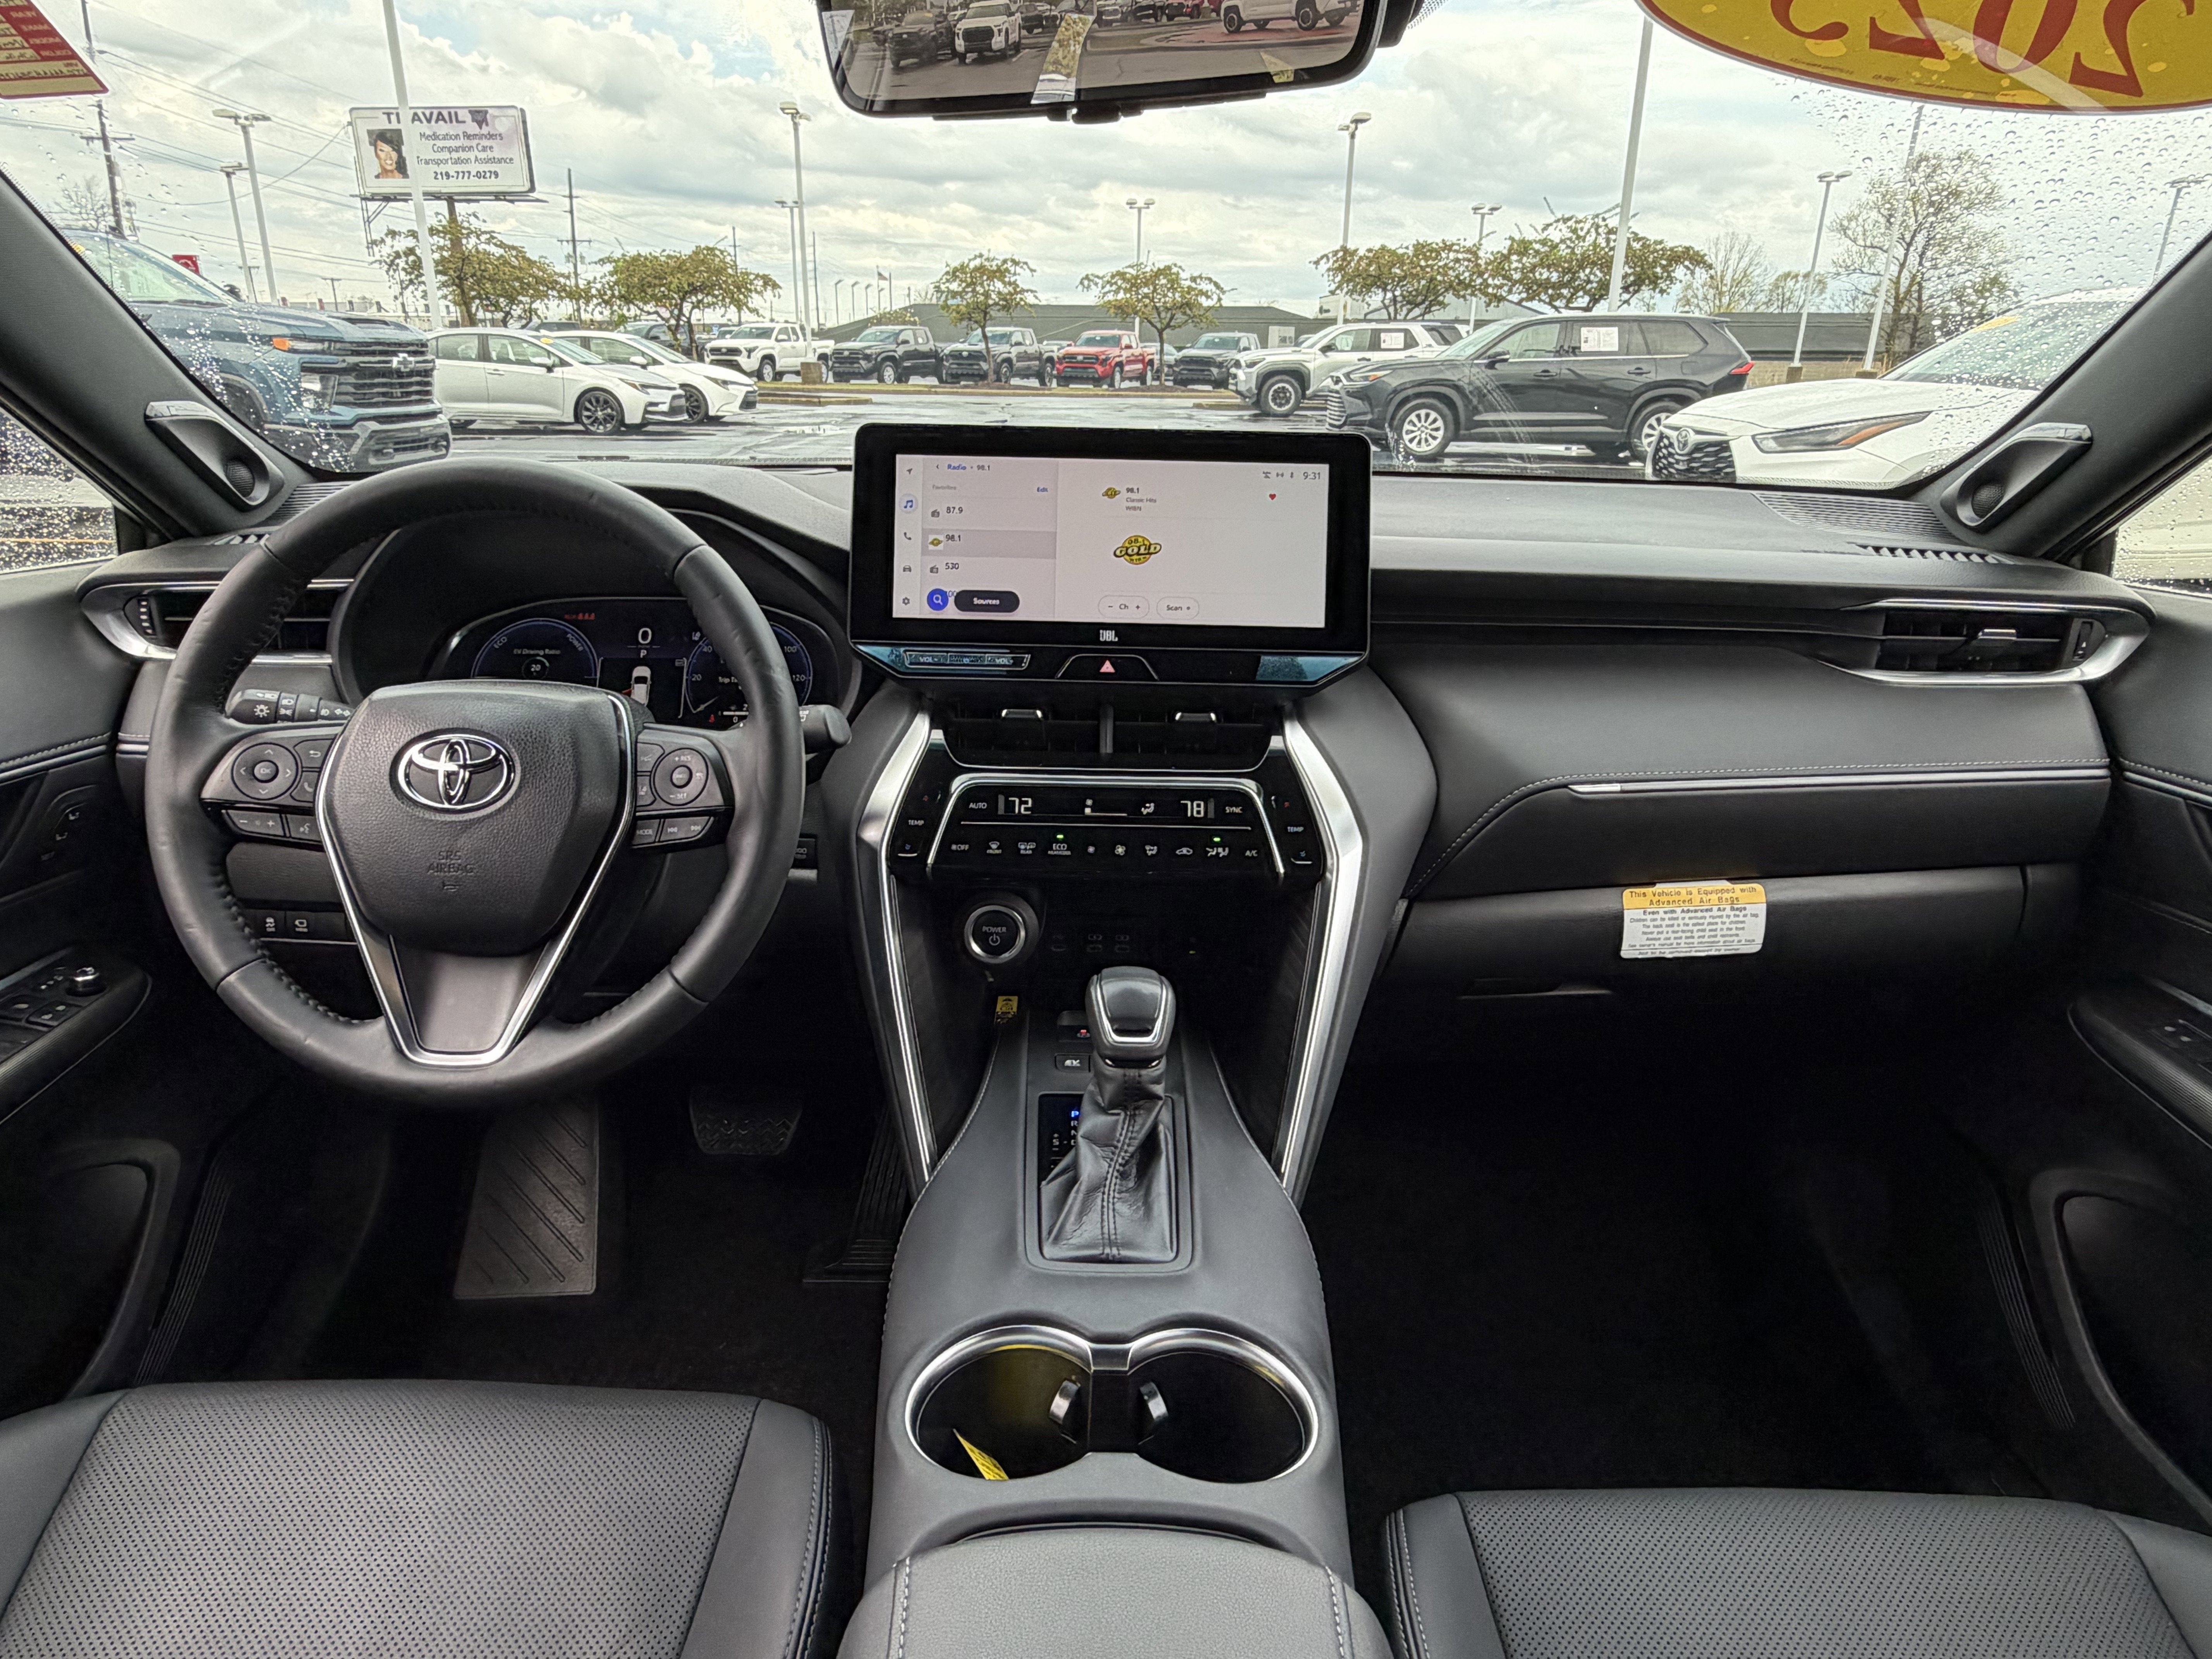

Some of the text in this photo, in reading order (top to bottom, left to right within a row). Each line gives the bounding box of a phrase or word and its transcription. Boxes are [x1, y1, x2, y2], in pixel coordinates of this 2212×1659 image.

[419, 131, 503, 141] Medication Reminders
[432, 144, 494, 155] Companion Care
[417, 156, 514, 167] Transportation Assistance
[433, 171, 499, 180] 219-777-0279
[1303, 472, 1321, 480] 9:31
[946, 506, 963, 514] 87.9
[1115, 543, 1161, 557] GOLD
[638, 628, 652, 644] 0
[1099, 630, 1118, 641] JBL
[1008, 797, 1032, 814] 72
[1181, 801, 1204, 818] 78
[1697, 887, 1735, 896] Equipped
[1649, 898, 1693, 906] Advanced
